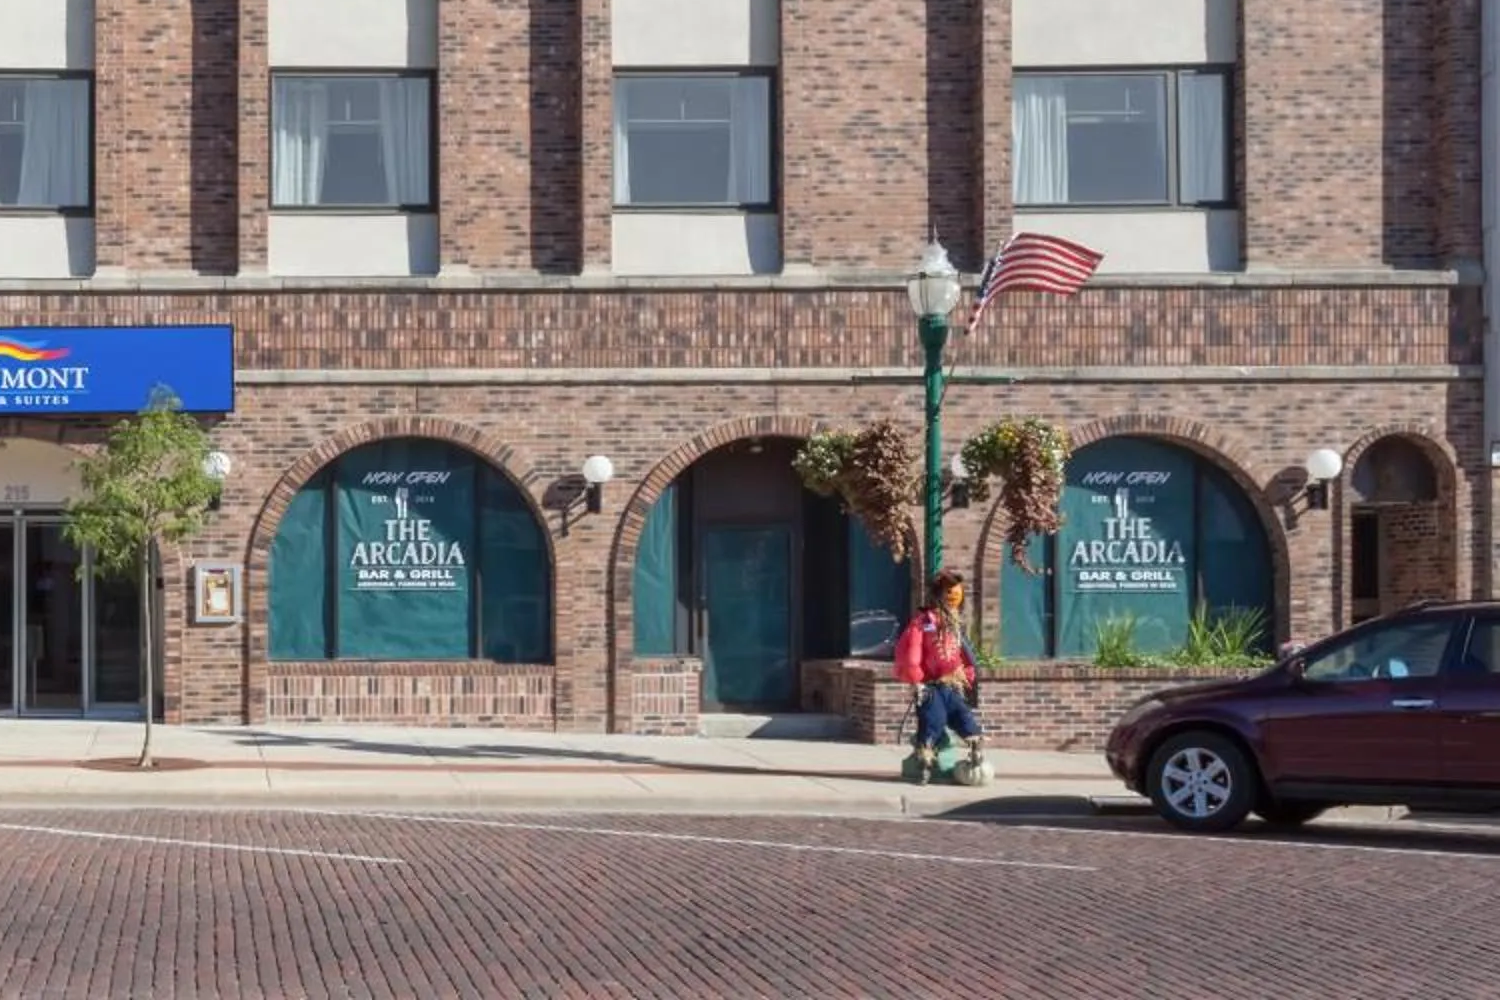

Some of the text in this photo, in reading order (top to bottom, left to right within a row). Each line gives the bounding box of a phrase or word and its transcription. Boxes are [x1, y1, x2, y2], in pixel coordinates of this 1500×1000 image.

[15, 395, 69, 405] SUITES
[362, 471, 451, 485] NOW OPEN
[1082, 471, 1171, 485] NOW OPEN
[384, 519, 431, 541] THE
[1103, 517, 1152, 539] THE
[351, 541, 465, 565] ARCADIA
[1071, 540, 1186, 564] ARCADIA
[358, 569, 453, 579] BAR & GRILL
[1079, 571, 1175, 581] BAR & GRILL
